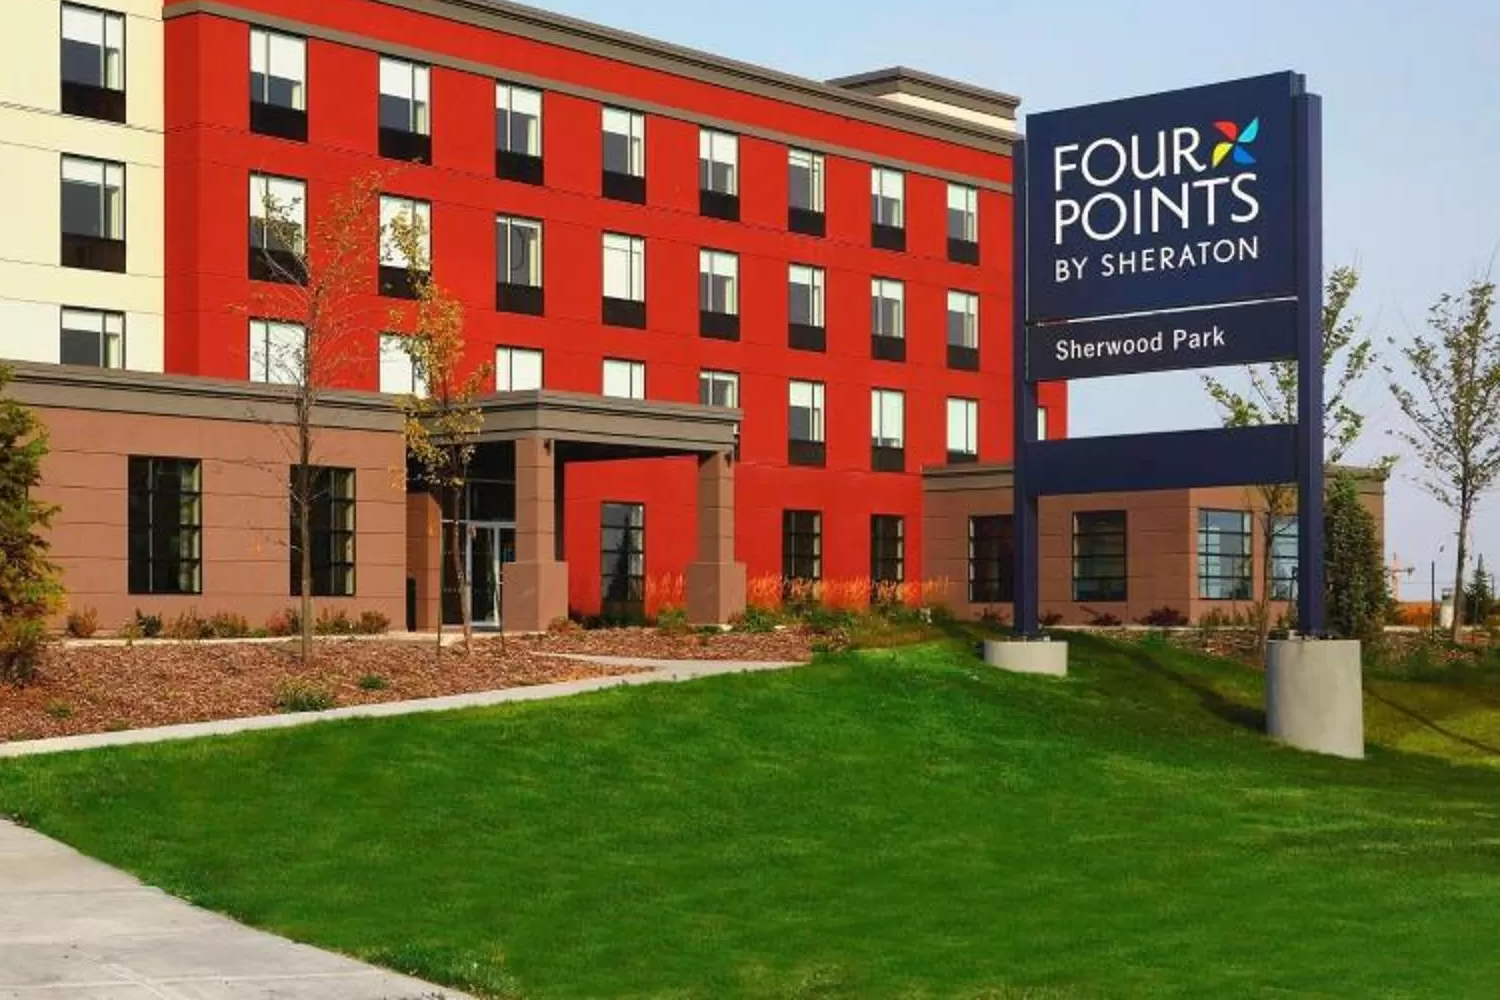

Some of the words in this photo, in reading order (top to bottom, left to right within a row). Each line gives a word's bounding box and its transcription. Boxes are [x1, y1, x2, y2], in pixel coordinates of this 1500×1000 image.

[1055, 127, 1206, 192] FOUR
[1055, 173, 1259, 245] POINTS
[1055, 256, 1088, 283] BY
[1101, 236, 1259, 277] SHERATON
[1055, 332, 1163, 361] Sherwood
[1173, 326, 1225, 350] Park
